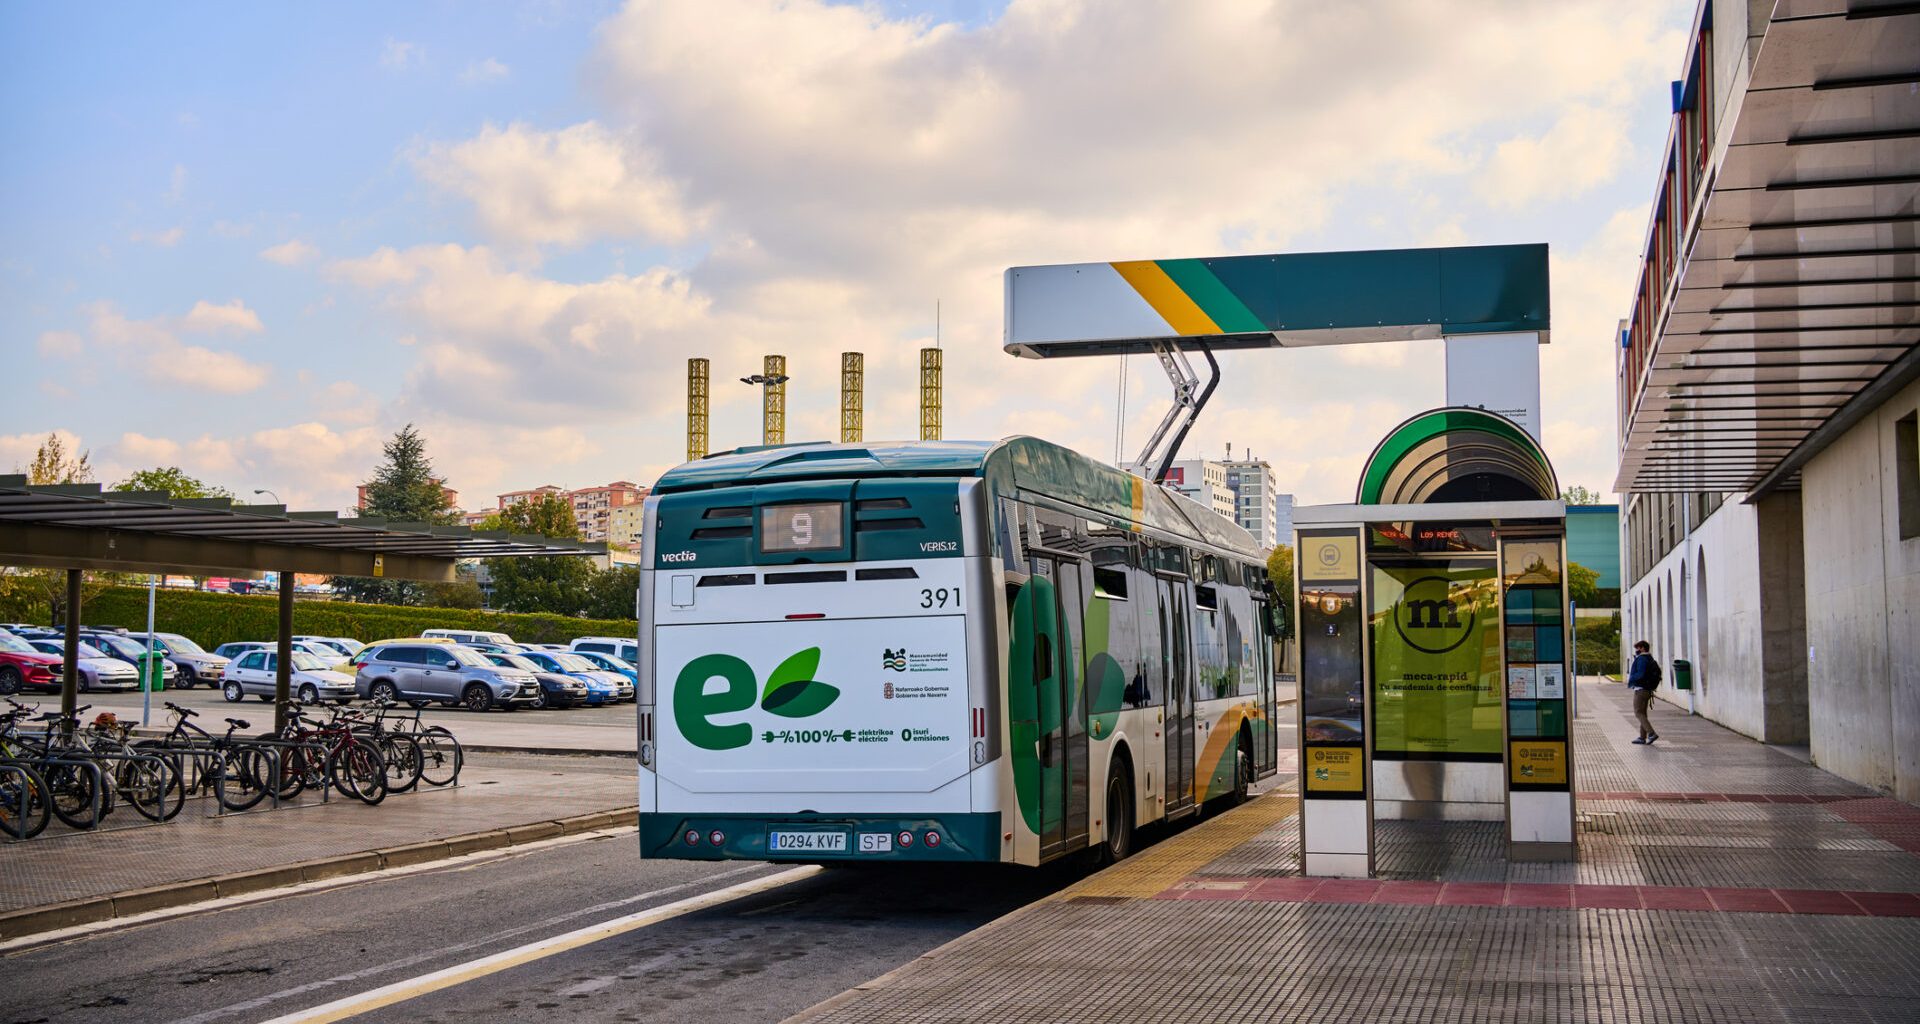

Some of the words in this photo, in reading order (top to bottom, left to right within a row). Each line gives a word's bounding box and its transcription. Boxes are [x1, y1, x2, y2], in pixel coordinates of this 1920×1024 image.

[791, 513, 813, 545] 9
[661, 551, 697, 563] vectia
[919, 587, 961, 609] 391
[1406, 600, 1462, 628] m
[1403, 672, 1468, 681] meca-rapid
[1436, 683, 1447, 691] de
[673, 653, 758, 751] e
[901, 728, 912, 742] 0
[913, 734, 950, 742] emisiones
[779, 834, 813, 848] 0294
[817, 834, 843, 848] KVF
